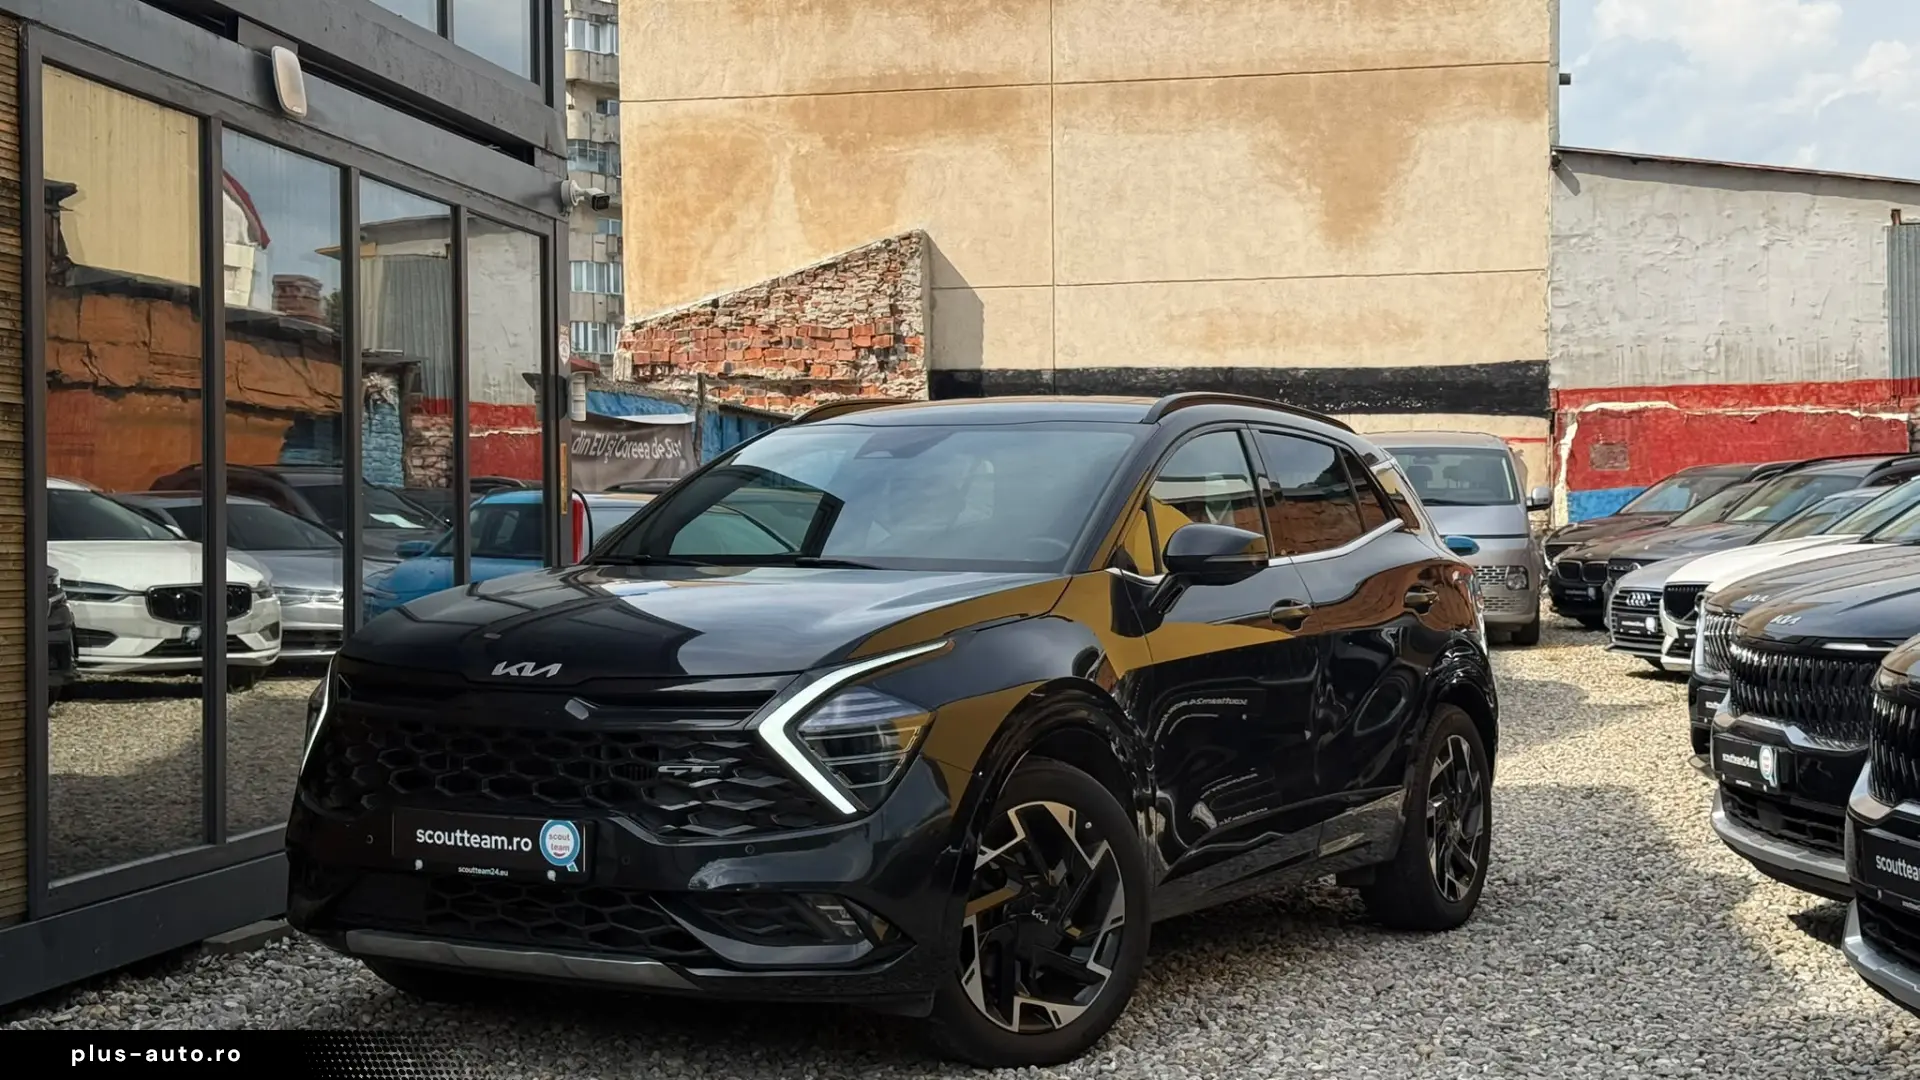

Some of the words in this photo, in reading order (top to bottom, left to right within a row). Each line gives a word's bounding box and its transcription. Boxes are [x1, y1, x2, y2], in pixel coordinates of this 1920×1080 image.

[571, 431, 591, 454] din
[590, 432, 609, 457] EU
[614, 435, 650, 459] Coreea
[651, 437, 666, 459] de
[491, 661, 563, 678] KIA
[416, 828, 533, 852] scoutteam.ro
[548, 833, 571, 841] scout
[551, 843, 570, 852] team
[1875, 855, 1920, 882] scouttea
